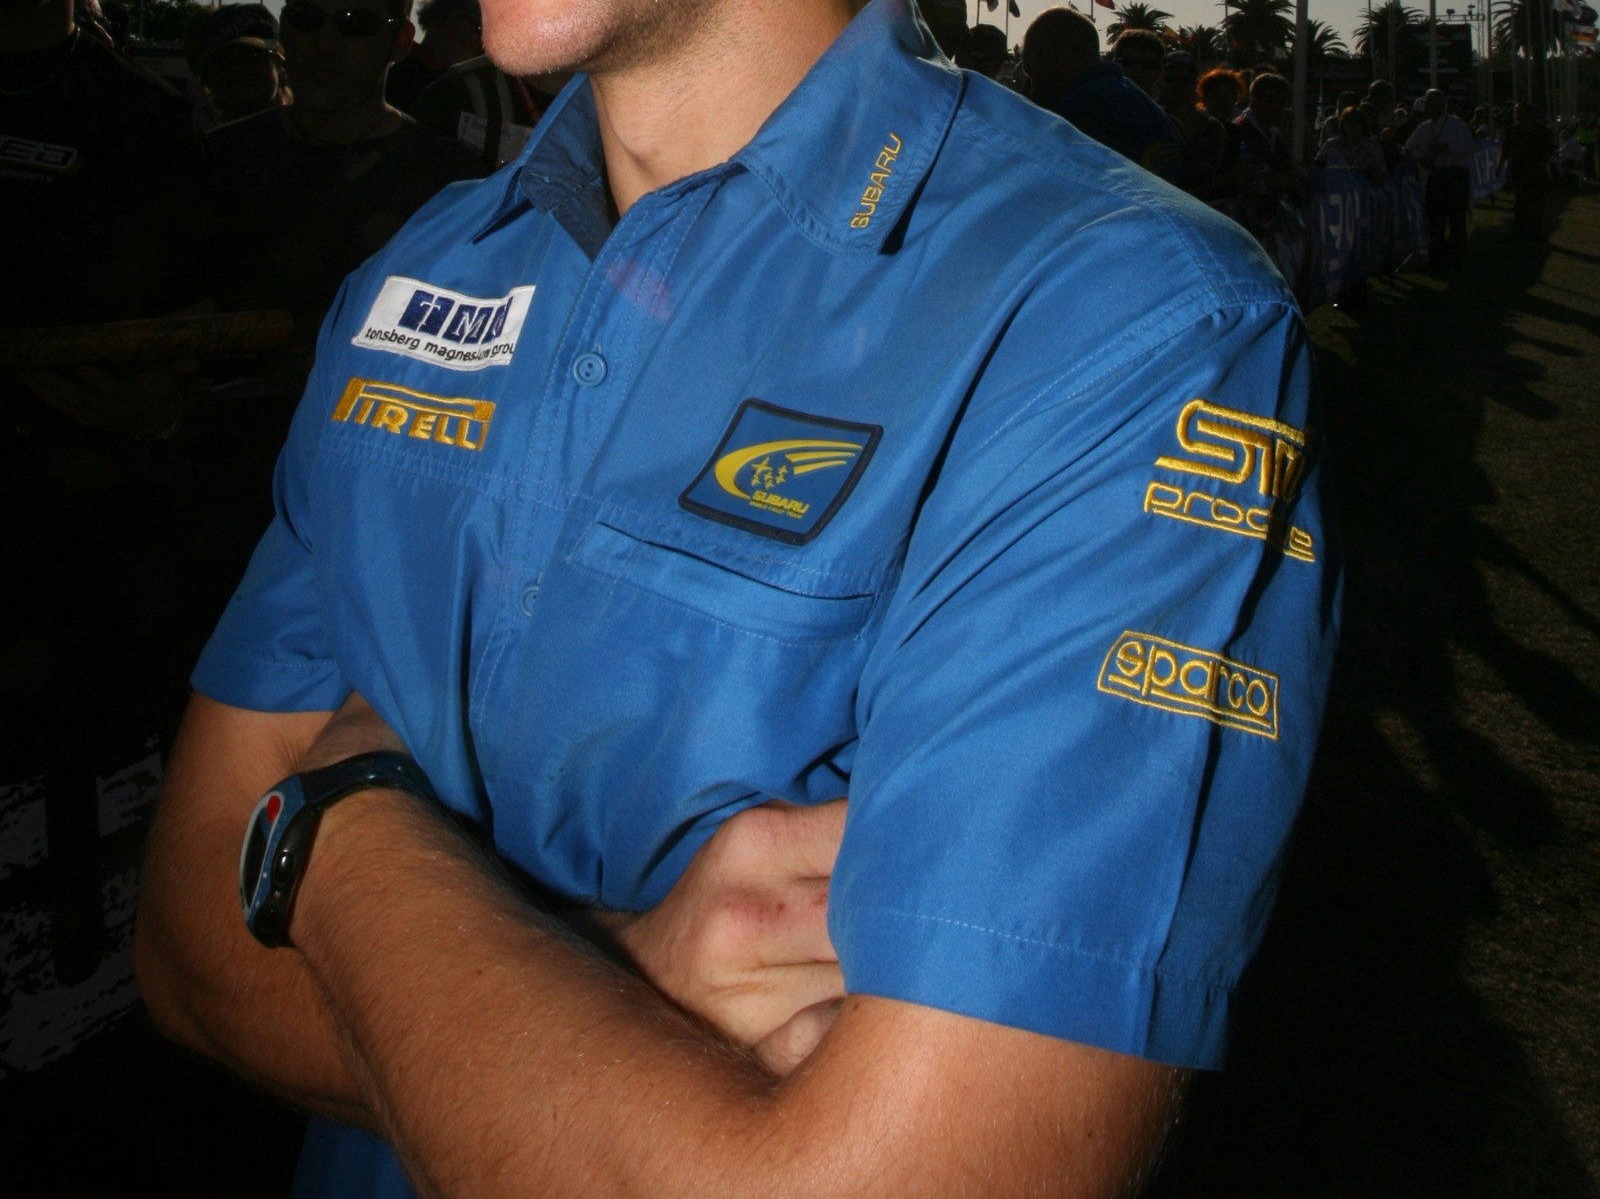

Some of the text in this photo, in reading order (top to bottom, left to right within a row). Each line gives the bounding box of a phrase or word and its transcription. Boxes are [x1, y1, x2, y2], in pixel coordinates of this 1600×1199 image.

[849, 131, 904, 229] SUBARU
[331, 378, 496, 452] PIRELLI
[752, 490, 810, 514] SUBARU
[1116, 640, 1272, 716] sparco
